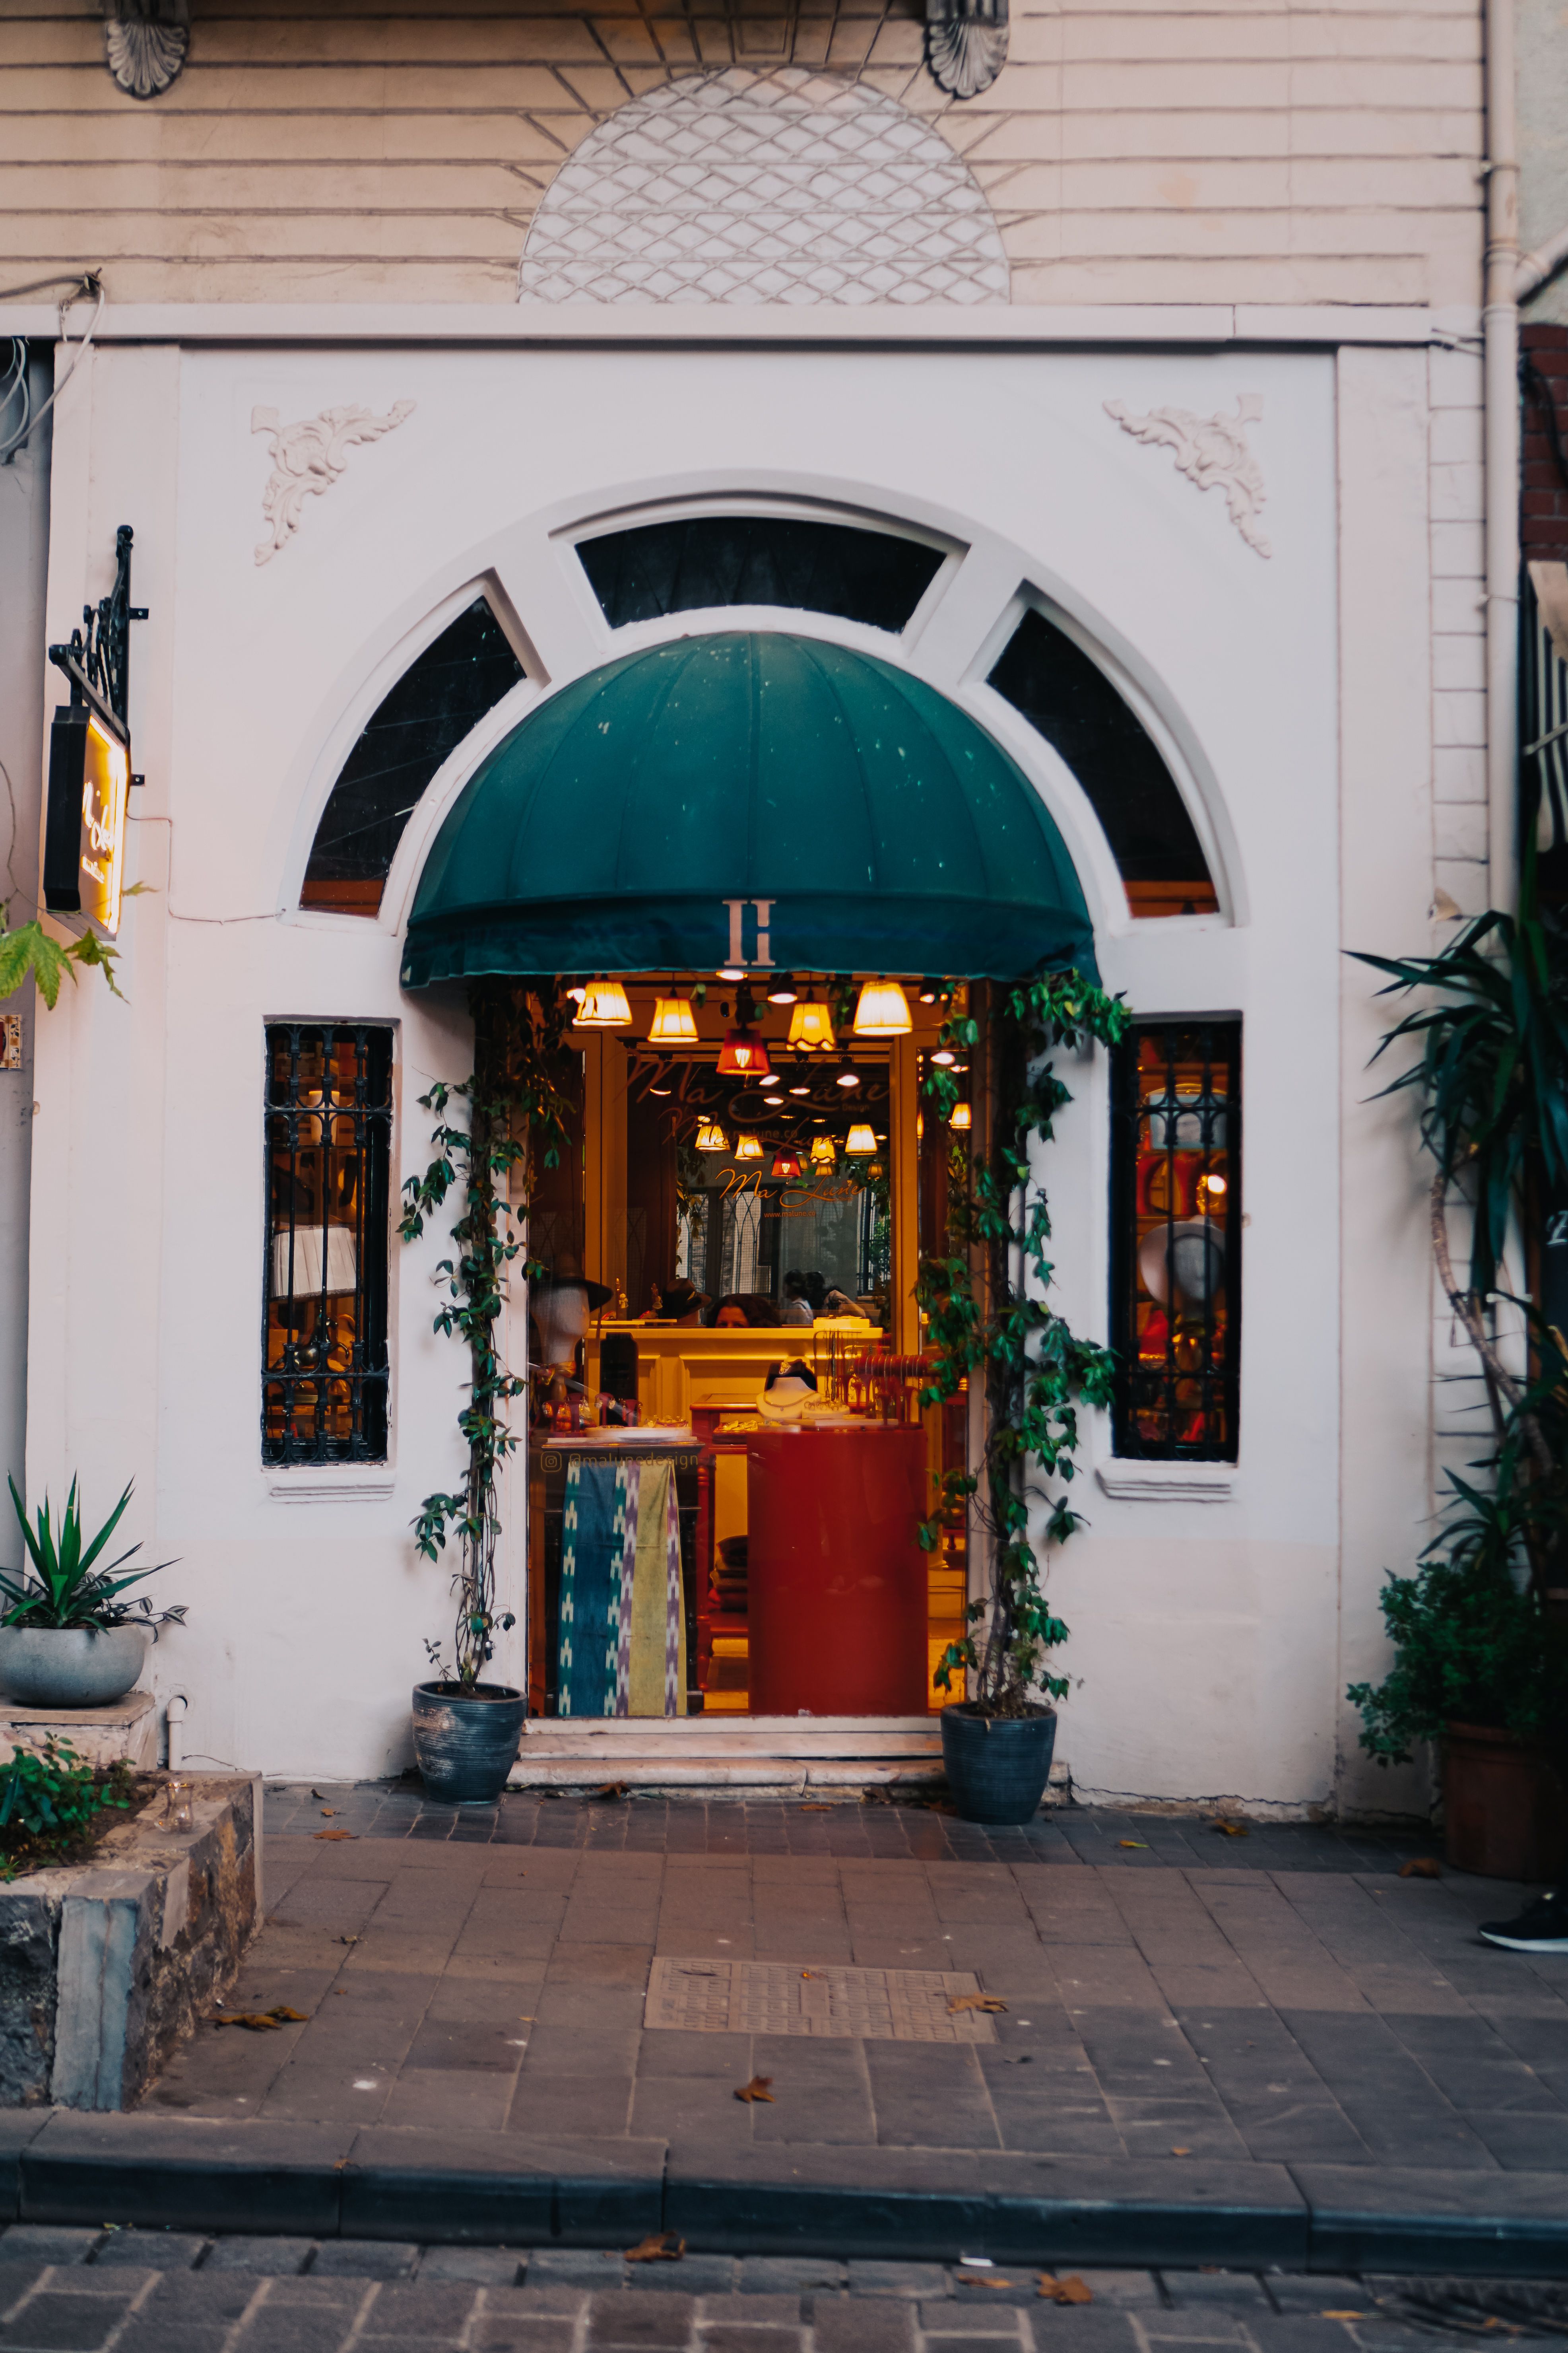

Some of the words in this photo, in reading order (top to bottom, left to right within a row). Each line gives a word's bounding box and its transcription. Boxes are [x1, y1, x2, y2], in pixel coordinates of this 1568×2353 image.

[604, 1049, 724, 1104] Ma
[728, 1058, 893, 1123] Lune
[658, 1107, 738, 1145] Ma
[842, 1103, 870, 1113] Design
[716, 1168, 778, 1199] Ma
[779, 1175, 866, 1208] Lune
[569, 1451, 699, 1469] @malunedesign
